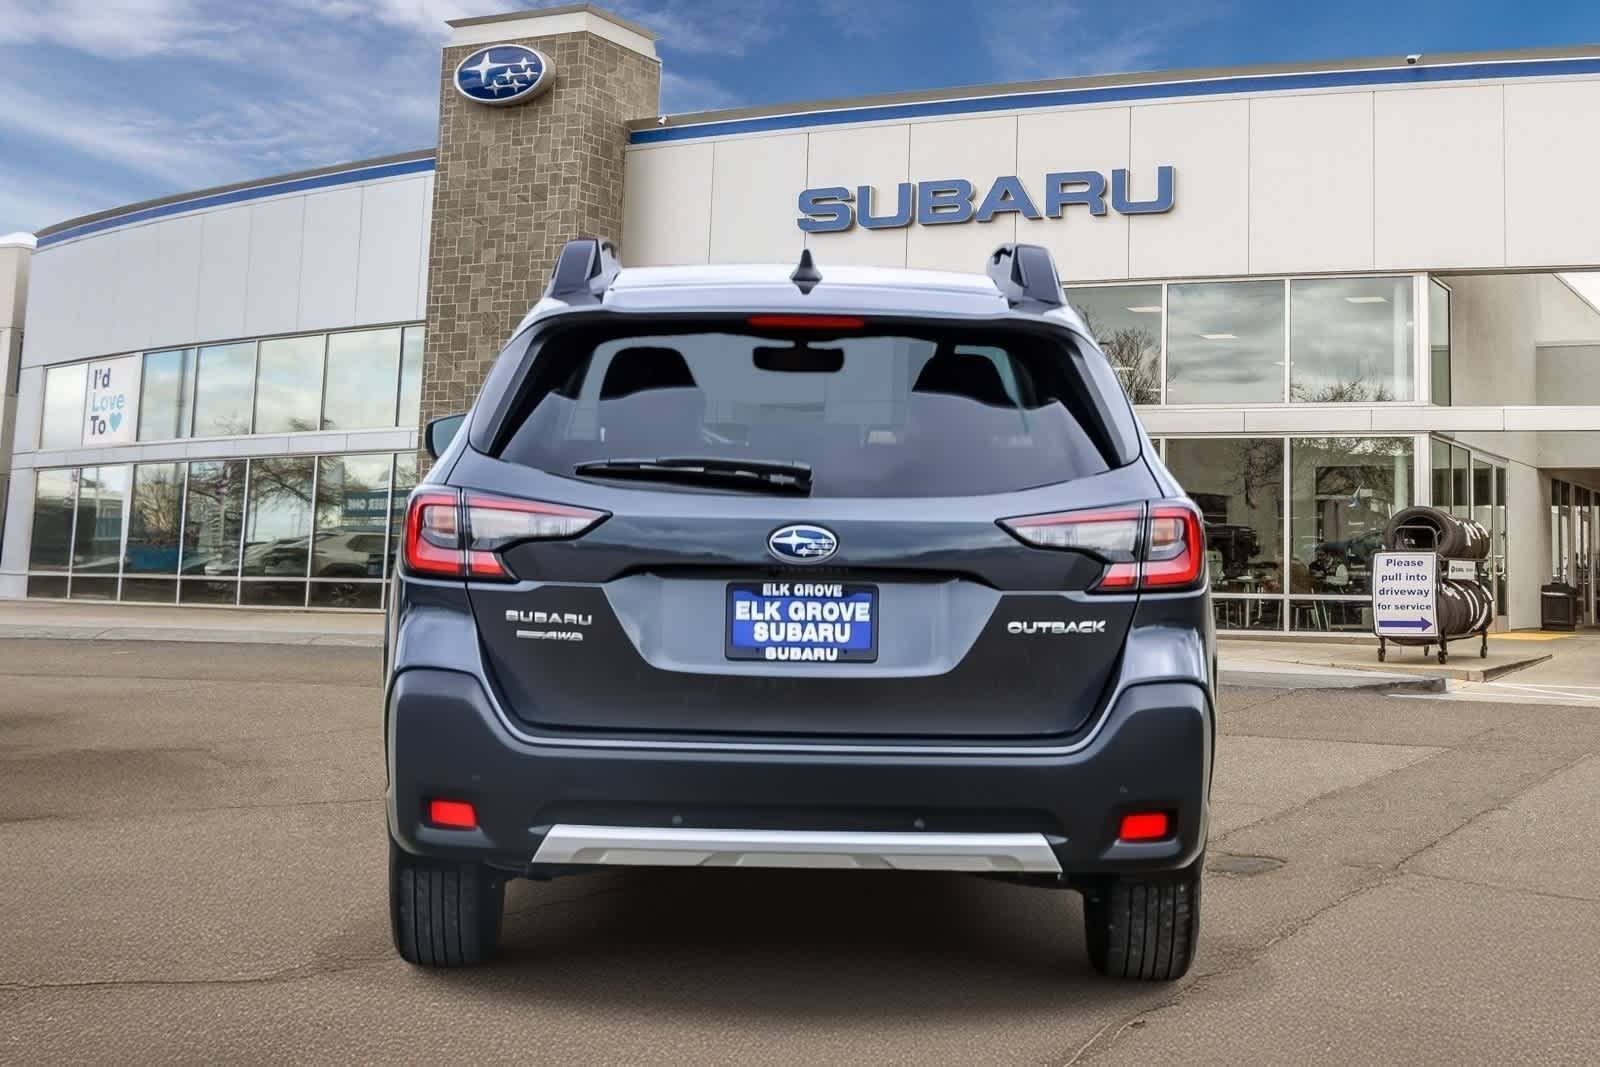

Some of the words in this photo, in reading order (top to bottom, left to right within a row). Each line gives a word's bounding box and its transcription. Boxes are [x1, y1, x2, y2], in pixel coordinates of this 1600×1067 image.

[797, 165, 1176, 233] SUBARU
[93, 368, 111, 389] I'd
[91, 392, 125, 412] Love
[90, 415, 106, 435] To
[1386, 558, 1424, 567] Please
[1381, 573, 1402, 583] pull
[1406, 573, 1428, 581] into
[762, 583, 790, 597] ELK
[794, 584, 842, 597] GROVE
[1378, 587, 1430, 597] driveway
[735, 600, 781, 621] ELK
[788, 601, 870, 622] GROVE
[1394, 603, 1432, 611] service
[505, 610, 592, 625] SUBARU
[753, 622, 851, 643] SUBARU
[1007, 620, 1106, 634] OUTBACK
[765, 647, 838, 661] SUBARU
